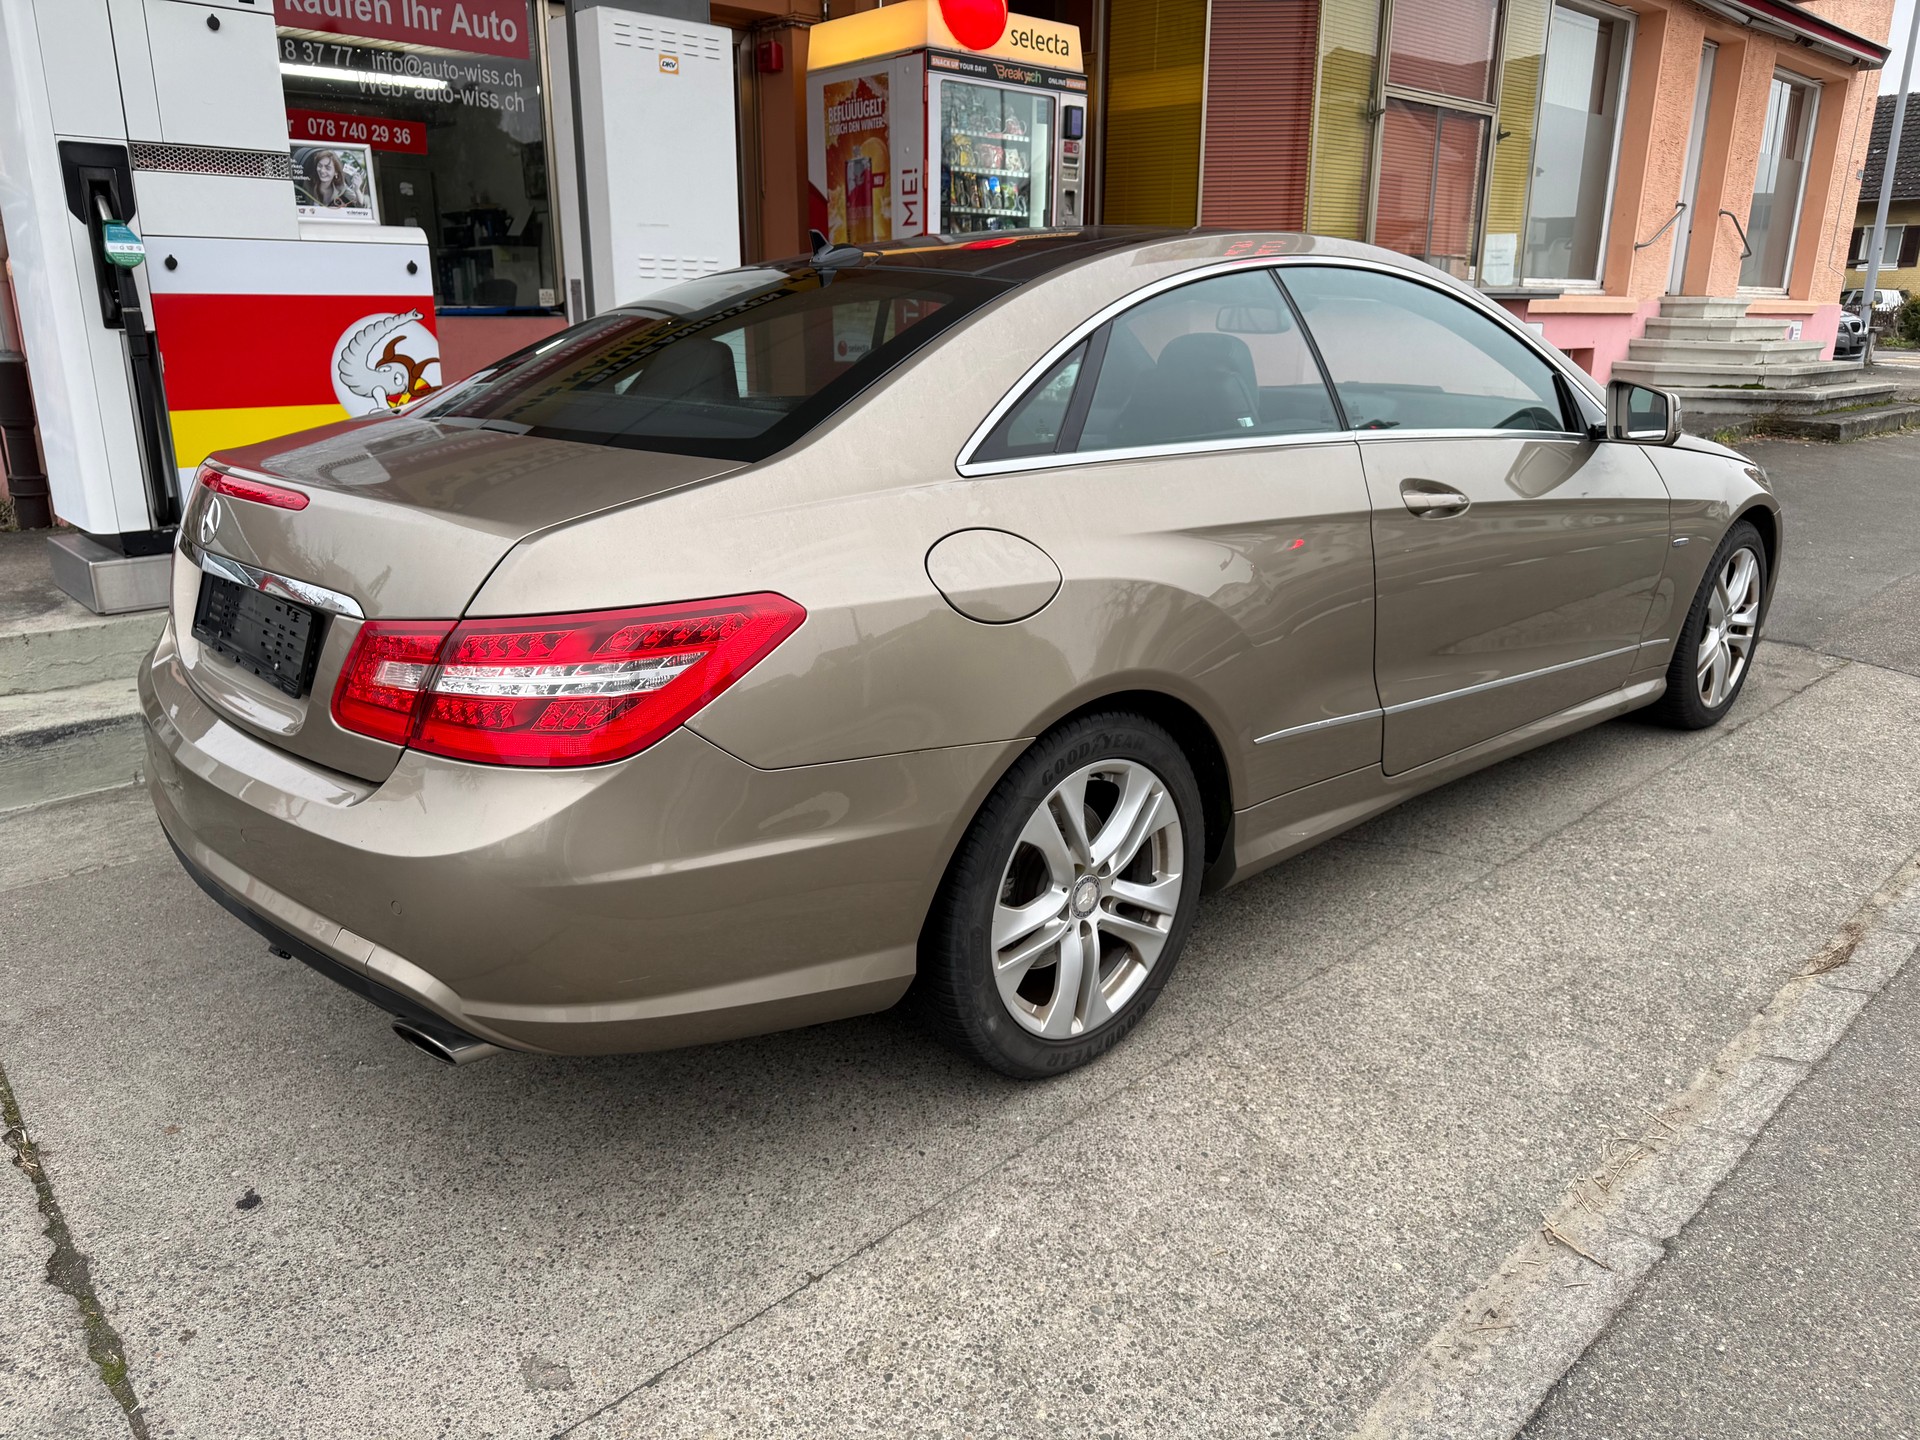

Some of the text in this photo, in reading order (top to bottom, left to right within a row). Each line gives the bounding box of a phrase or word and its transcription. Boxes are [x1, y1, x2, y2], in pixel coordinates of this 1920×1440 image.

[402, 0, 442, 32] Ihr
[450, 3, 518, 43] Auto
[1009, 28, 1070, 56] selecta
[302, 41, 325, 64] 37
[330, 44, 353, 67] 77
[371, 49, 523, 88] info@auto-wiss.ch
[661, 60, 677, 69] DKV
[960, 62, 974, 71] YOUR
[974, 64, 987, 74] DAY!
[1048, 77, 1066, 87] ONLINE
[413, 83, 526, 113] auto-wiss.ch
[828, 97, 883, 123] BEFLÜÜÜGELT
[307, 117, 336, 137] 078
[340, 121, 367, 140] 740
[371, 124, 389, 143] 29
[393, 127, 411, 145] 36
[829, 122, 848, 137] DURCH
[848, 120, 861, 133] DEN
[902, 168, 918, 227] ME!
